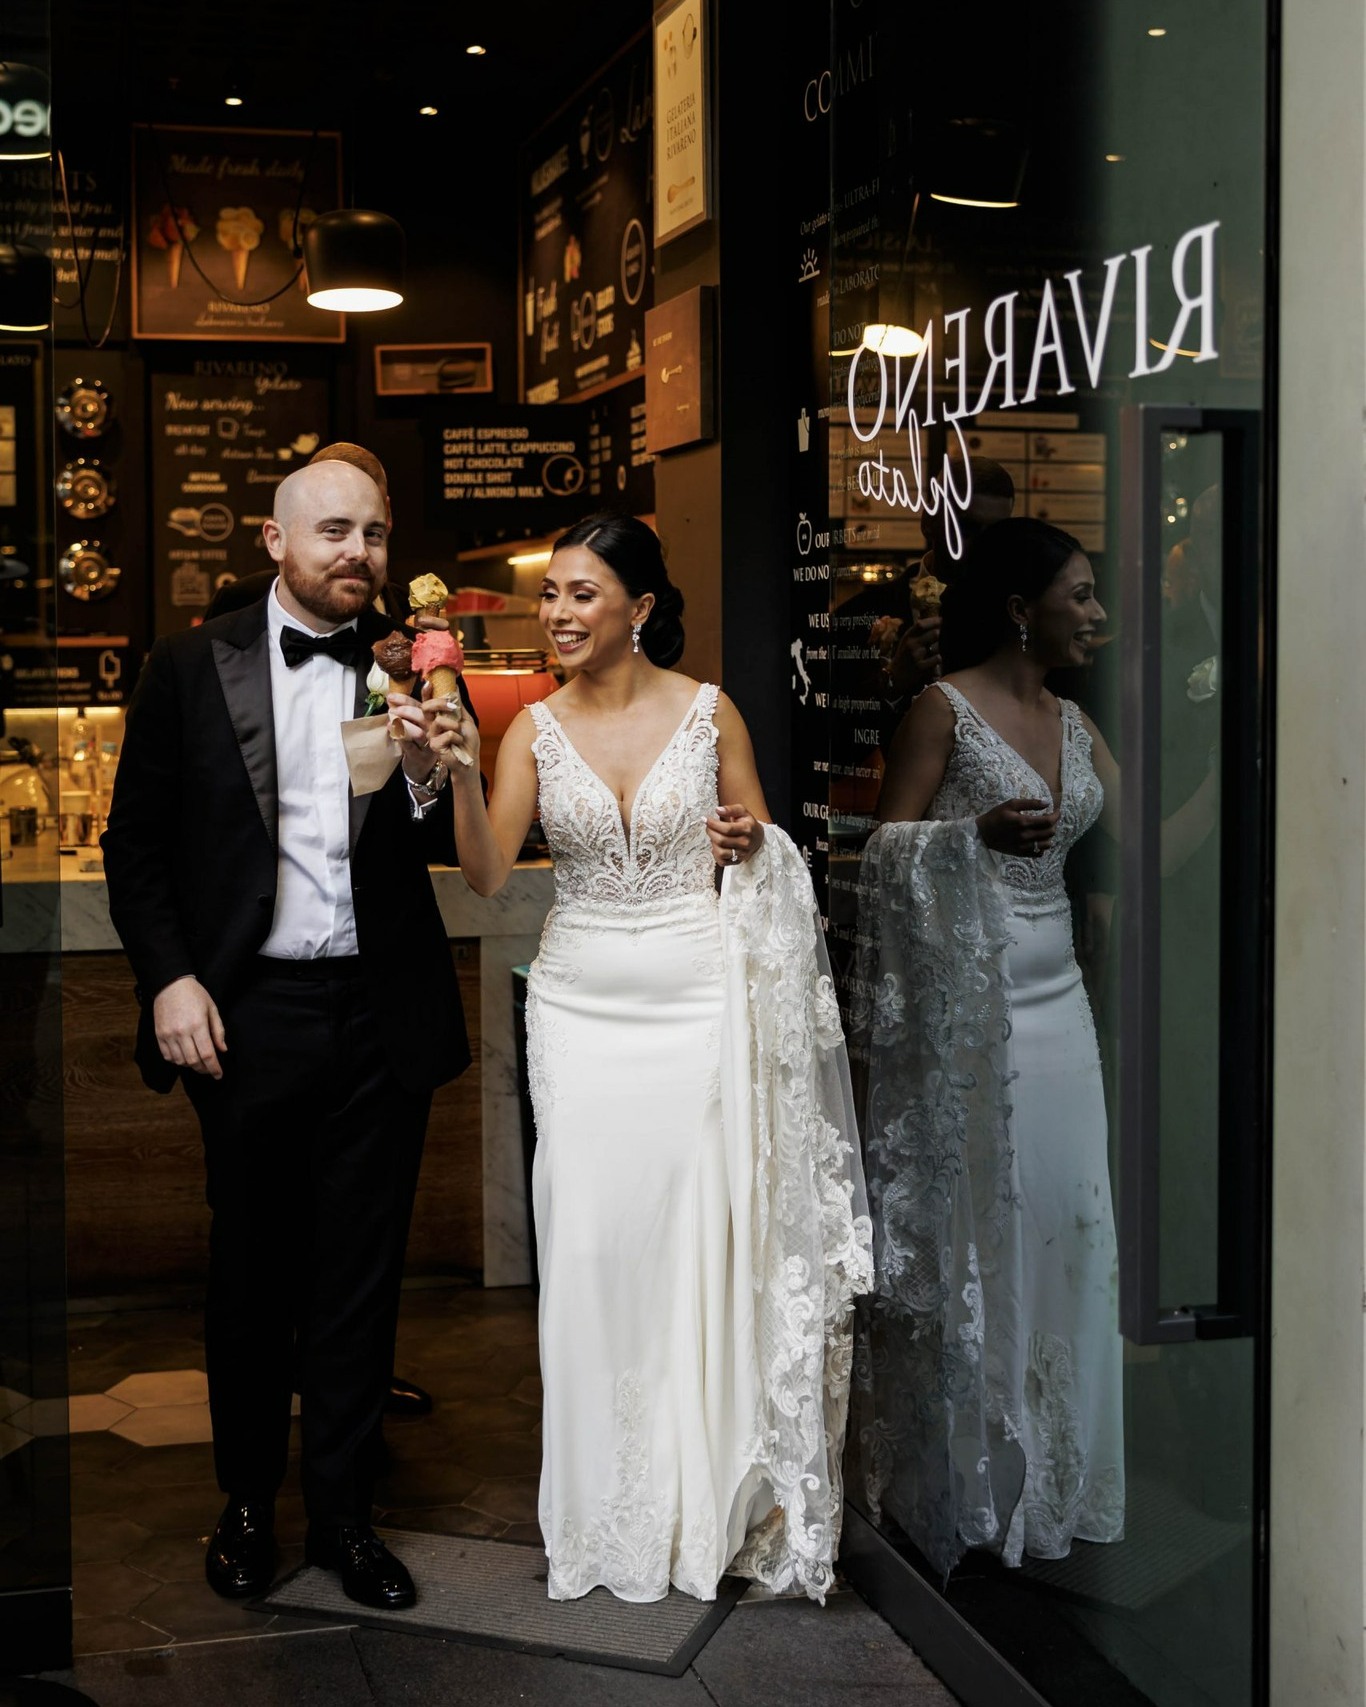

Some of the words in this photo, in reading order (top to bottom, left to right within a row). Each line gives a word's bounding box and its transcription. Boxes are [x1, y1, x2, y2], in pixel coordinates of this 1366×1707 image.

[666, 93, 696, 125] GELATERIA
[666, 111, 696, 144] ITALIANA
[666, 128, 696, 161] RIVARENO
[476, 426, 529, 440] ESPRESSO
[511, 440, 576, 455] CAPPUCCINO
[443, 456, 464, 470] HOT
[465, 455, 525, 470] CHOCOLATE
[443, 470, 483, 485] DOUBLE
[484, 470, 513, 485] SHOT
[443, 486, 465, 500] SOY
[473, 486, 516, 499] ALMOND
[517, 485, 544, 499] MILK
[793, 567, 805, 582] WE
[805, 566, 817, 581] DO
[818, 564, 830, 581] NO
[808, 613, 819, 629] WE
[814, 692, 826, 708] WE
[803, 802, 819, 819] OUR
